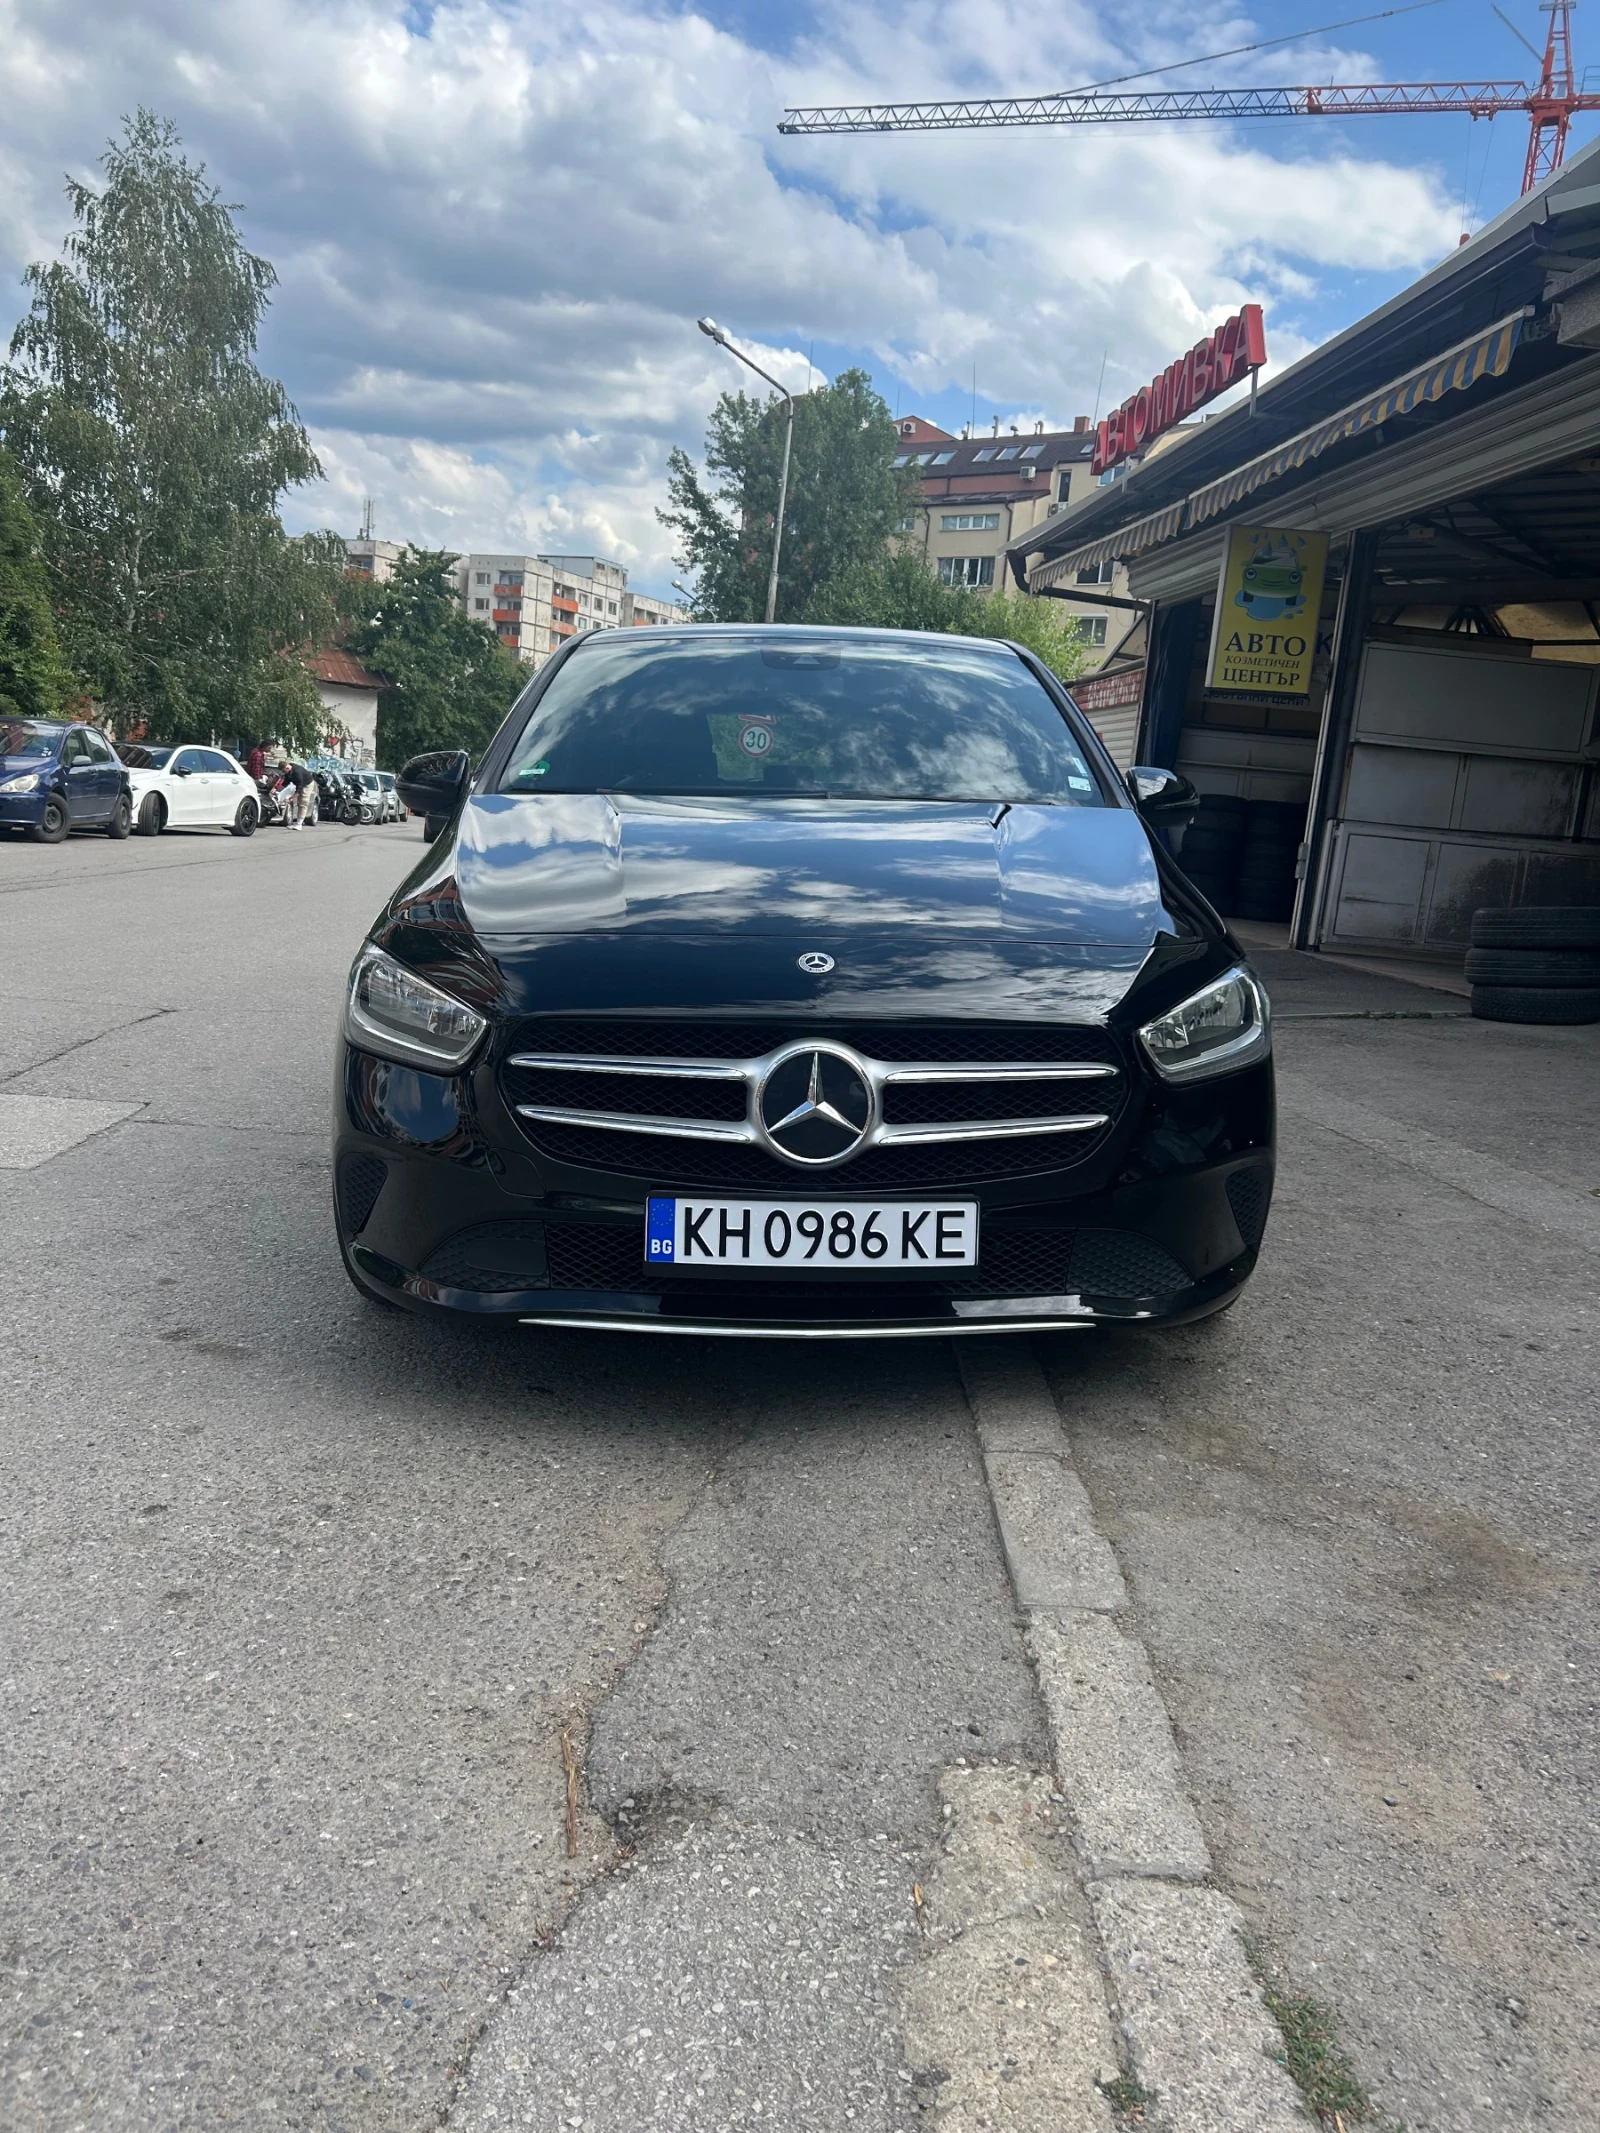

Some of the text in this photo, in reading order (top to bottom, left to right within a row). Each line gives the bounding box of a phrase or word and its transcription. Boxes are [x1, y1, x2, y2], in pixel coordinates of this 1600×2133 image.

[1091, 304, 1267, 476] АВТОМИВКА
[1224, 631, 1307, 657] АВТО
[1225, 655, 1300, 669] КОЗМЕТИЧЕН
[1222, 668, 1301, 686] ЦЕНТЪР
[745, 730, 767, 750] 30
[763, 1209, 888, 1259] 0986
[651, 1239, 673, 1254] BG
